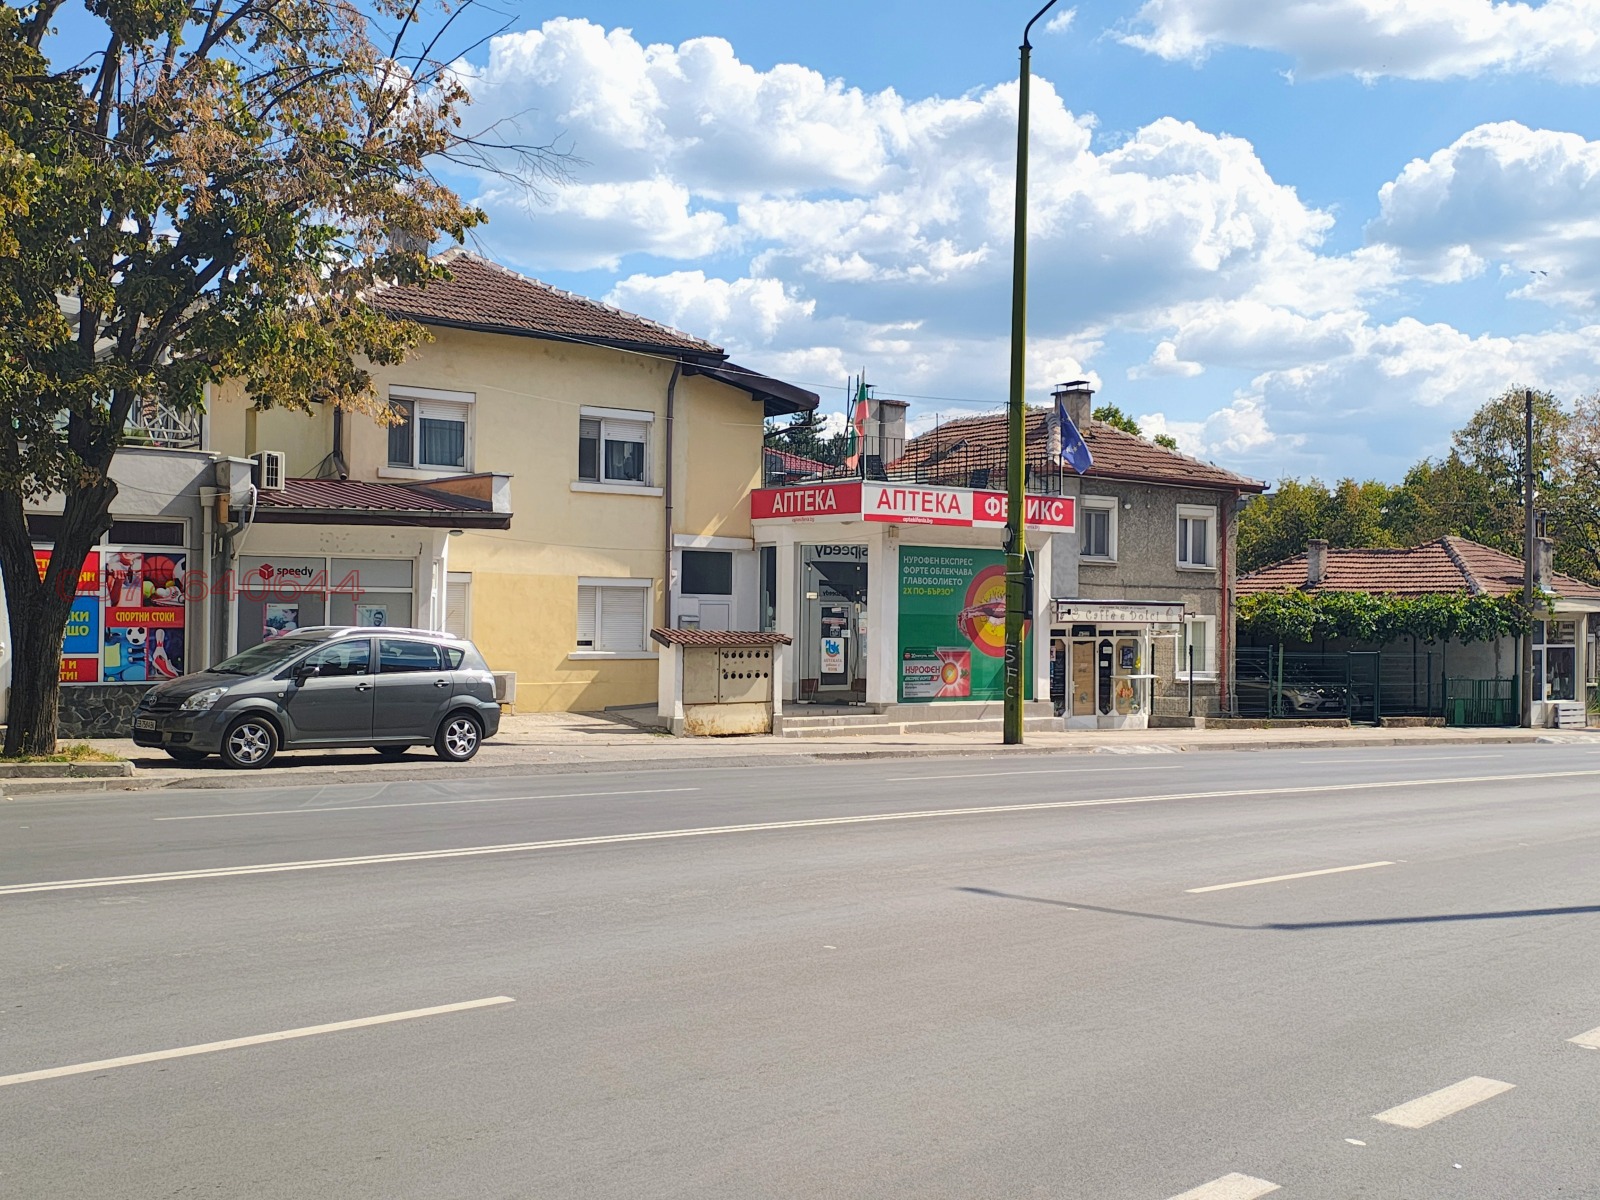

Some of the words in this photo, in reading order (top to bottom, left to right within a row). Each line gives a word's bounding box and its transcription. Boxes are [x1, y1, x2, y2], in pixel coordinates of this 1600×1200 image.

[772, 488, 837, 514] АПТЕКА
[876, 488, 962, 514] АПТЕКА
[984, 496, 1064, 521] ФЕИКС
[903, 556, 940, 564] НУРОФЕН
[940, 557, 973, 566] ЕКСПРЕС
[276, 566, 314, 578] speedy
[903, 566, 929, 574] ФОРТЕ
[929, 567, 973, 576] ОБЛЕКЧАВА
[903, 576, 963, 586] ГЛАВОБОЛИЕТО
[69, 611, 90, 622] КИ
[115, 612, 150, 622] СПОРТНИ
[151, 612, 175, 622] СТОКИ
[905, 665, 941, 674] НУРОФЕН
